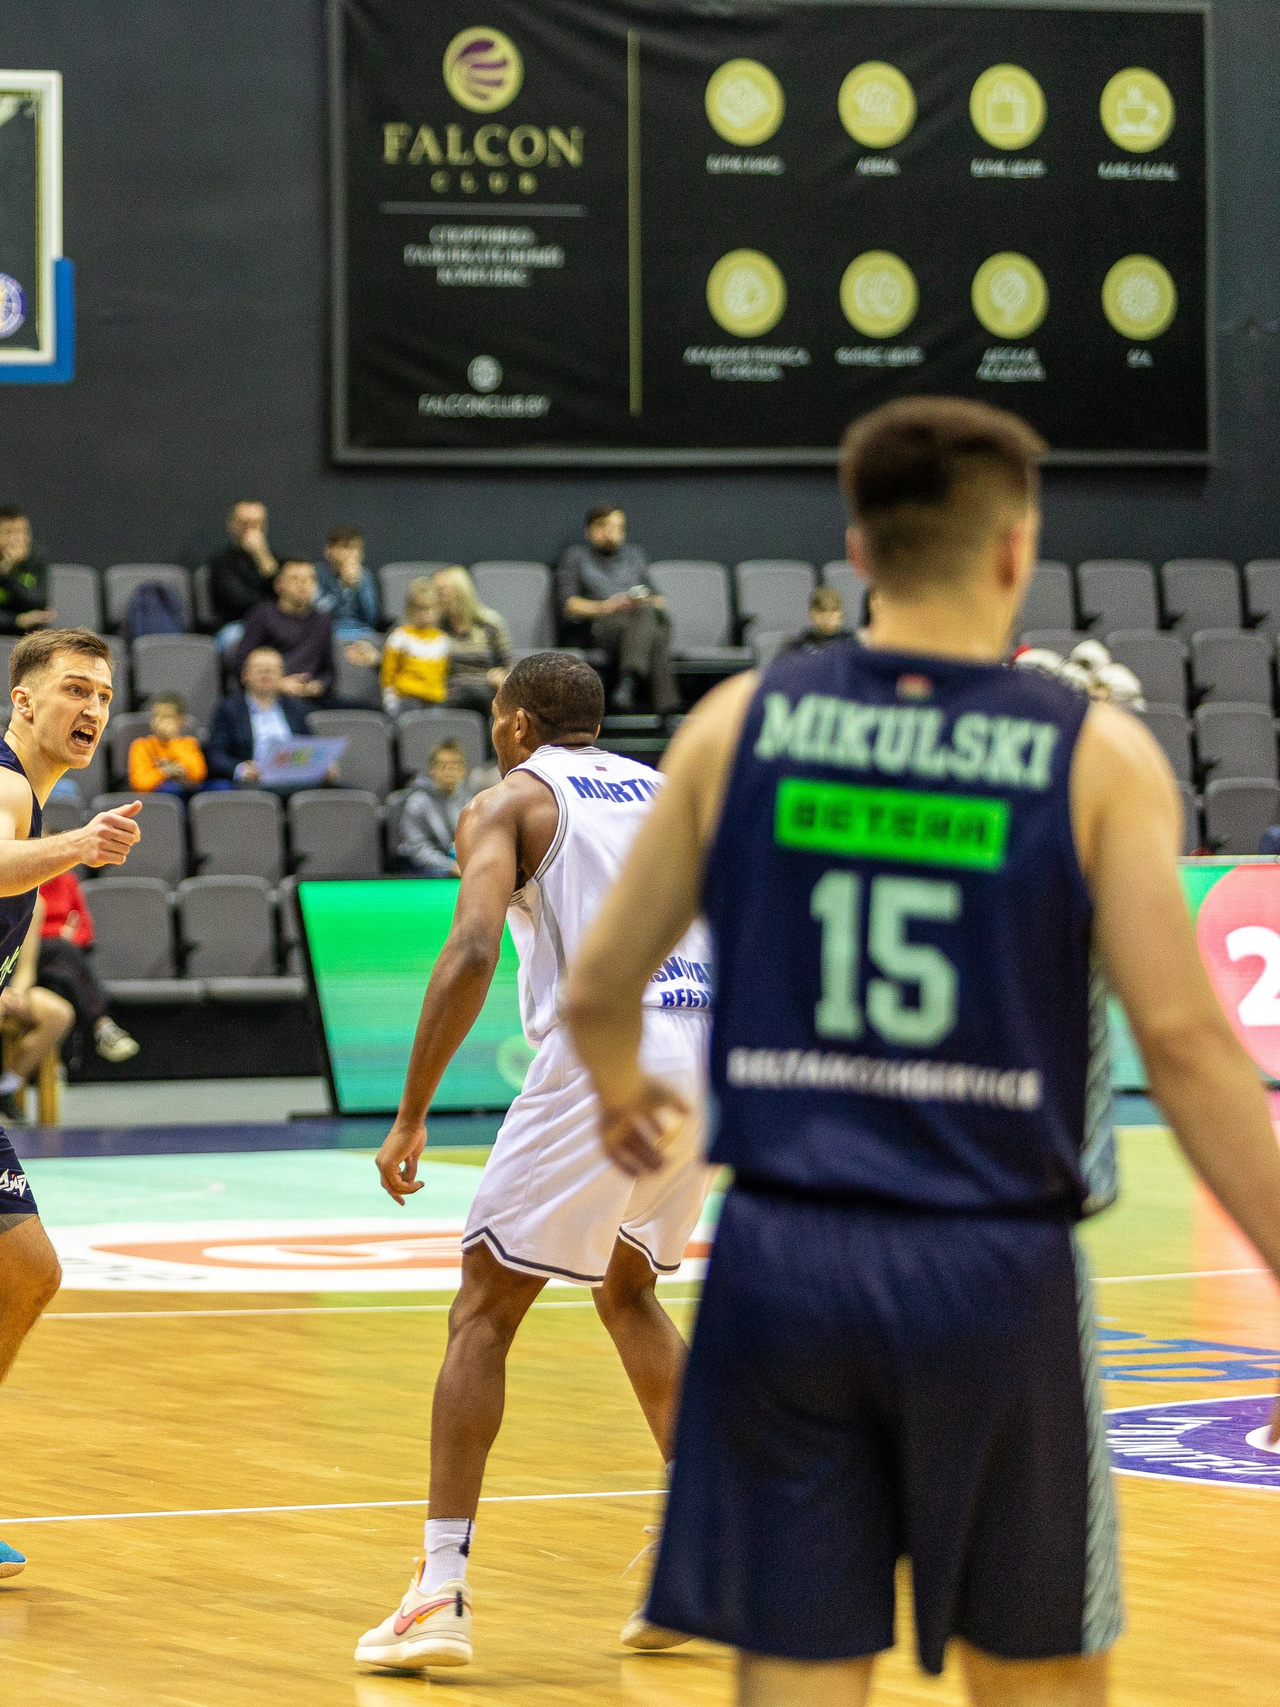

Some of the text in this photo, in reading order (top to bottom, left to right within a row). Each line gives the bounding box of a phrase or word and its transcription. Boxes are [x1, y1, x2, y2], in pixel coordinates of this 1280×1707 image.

[383, 122, 584, 168] FALCON
[754, 692, 1058, 790] MIKULSKI
[810, 869, 961, 1048] 15
